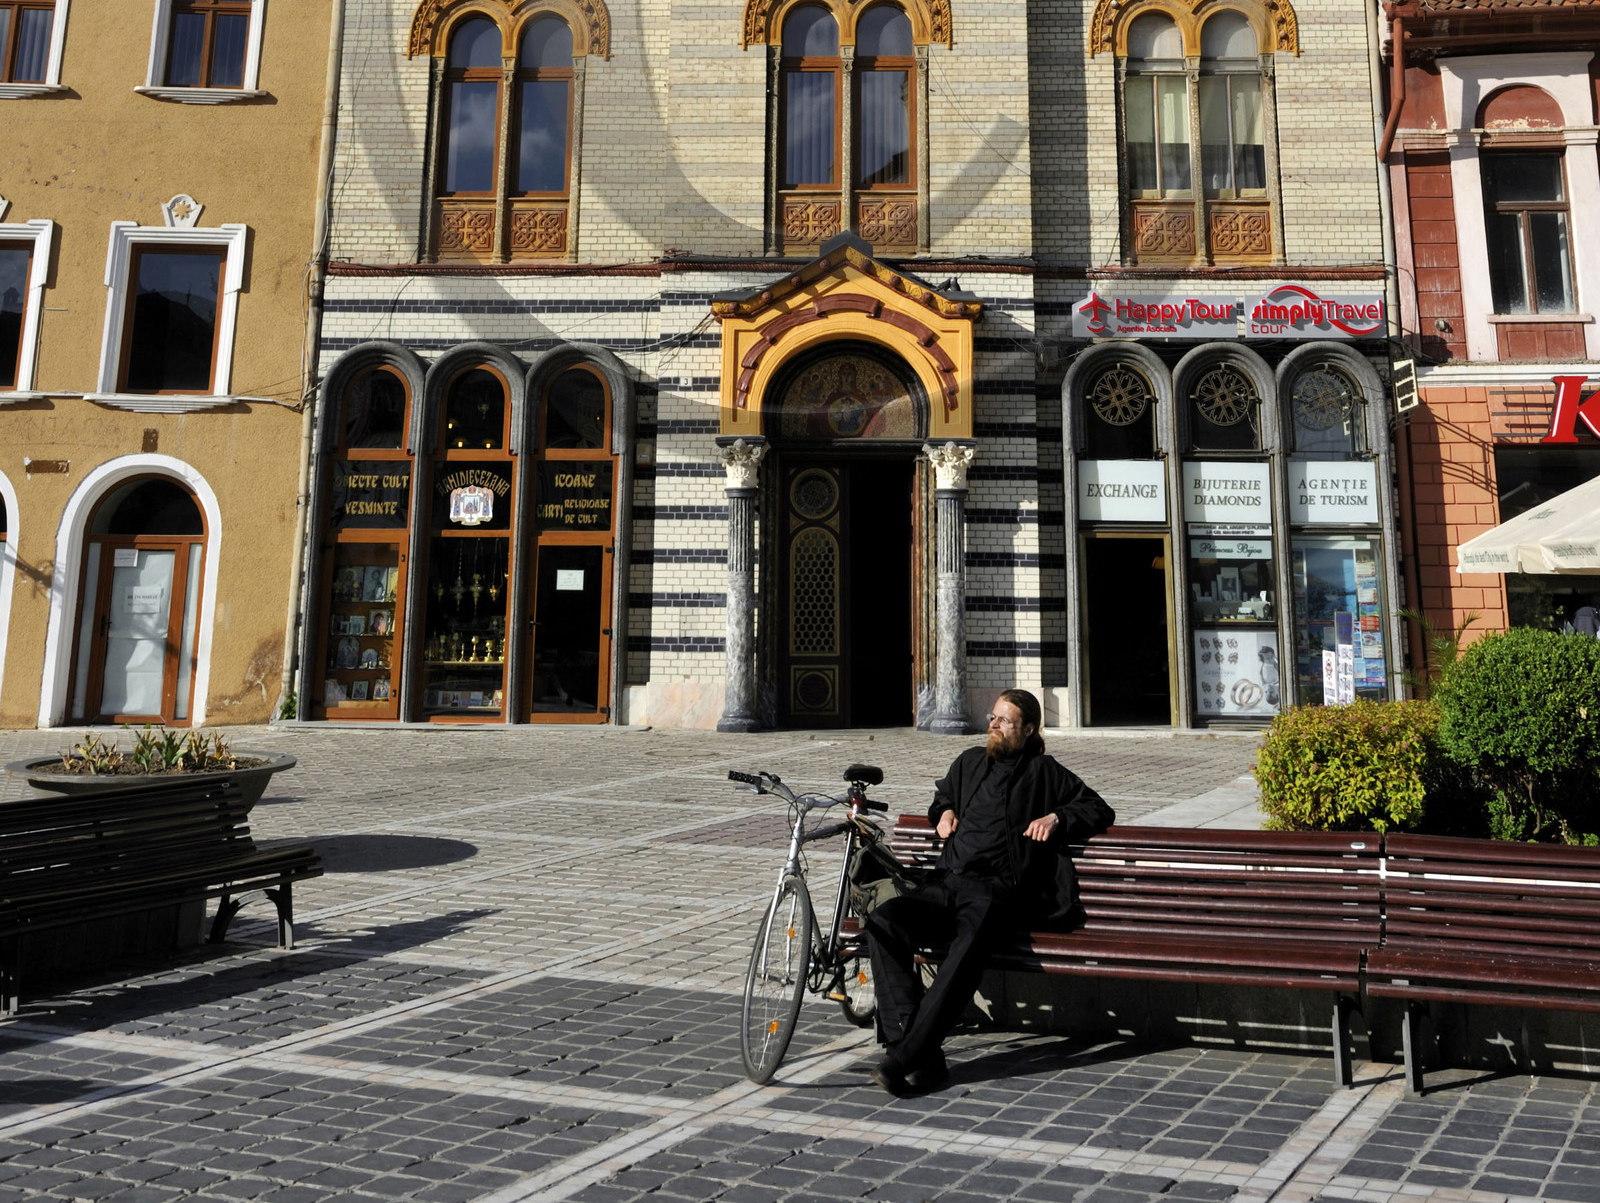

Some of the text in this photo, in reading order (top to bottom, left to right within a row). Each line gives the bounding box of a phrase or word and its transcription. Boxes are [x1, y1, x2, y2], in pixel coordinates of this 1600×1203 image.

[1116, 299, 1233, 323] HappyTour
[1252, 299, 1384, 325] simplyTravel
[1117, 325, 1177, 333] Agentie Asociata
[1251, 323, 1289, 334] tour
[382, 475, 409, 488] CULT
[555, 474, 596, 488] ICOANE
[1193, 479, 1261, 491] BIJUTERIE
[1086, 483, 1158, 498] EXCHANGE
[564, 499, 610, 509] RELIGIOASE
[1194, 495, 1262, 506] DIAMONDS
[1299, 495, 1368, 506] DE TURISM
[345, 501, 398, 515] VESMINTE
[565, 514, 598, 524] DE CULT
